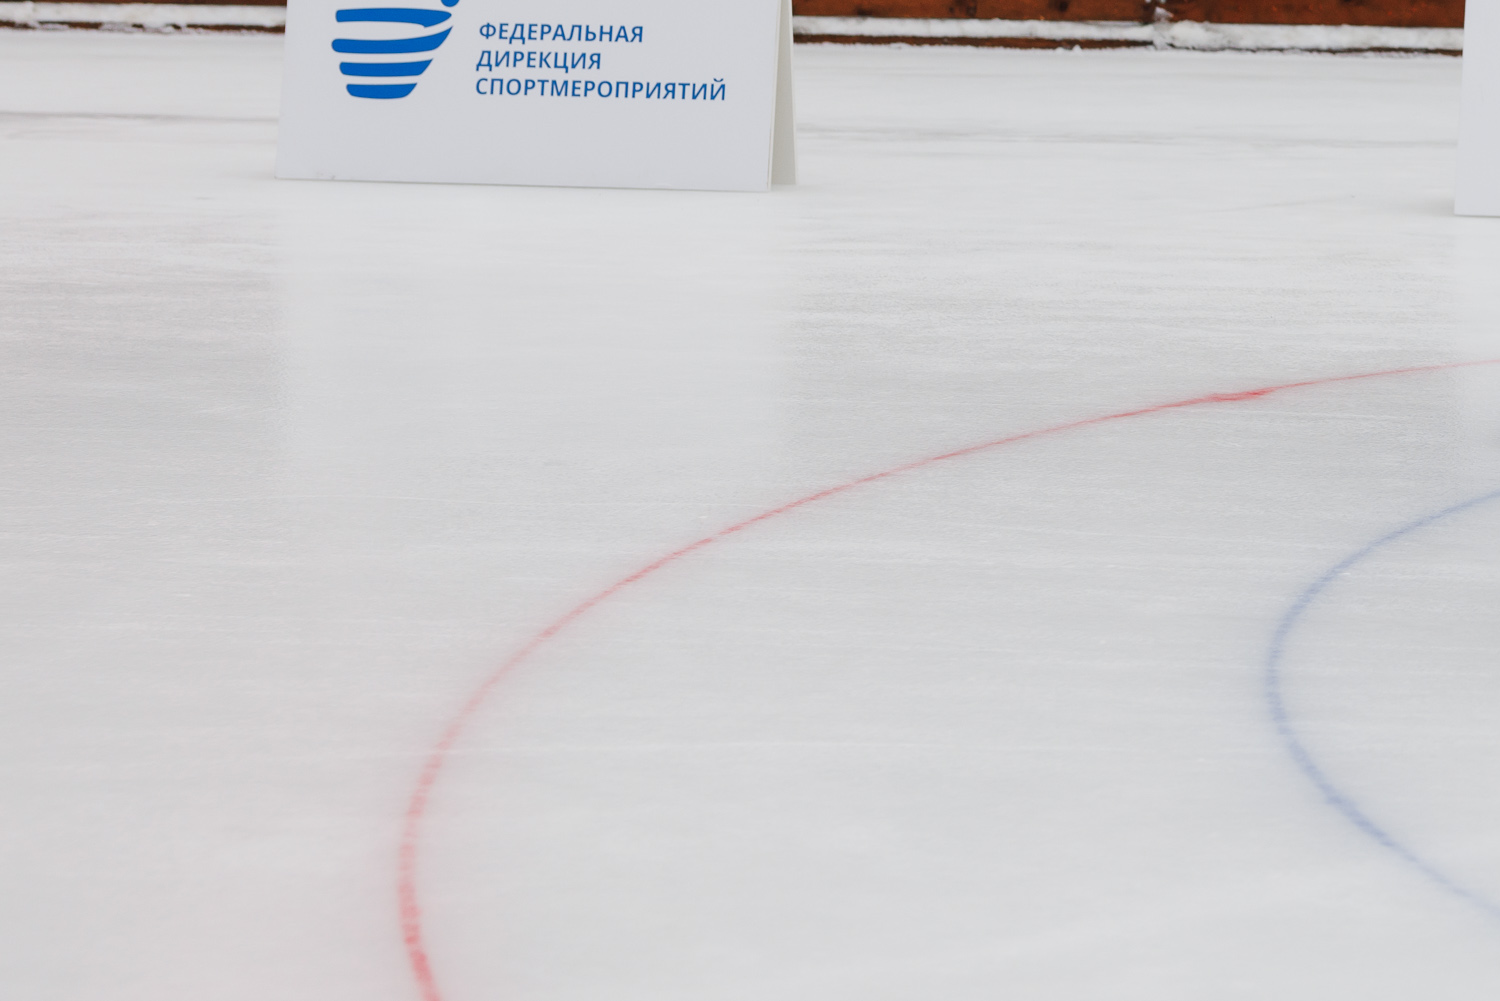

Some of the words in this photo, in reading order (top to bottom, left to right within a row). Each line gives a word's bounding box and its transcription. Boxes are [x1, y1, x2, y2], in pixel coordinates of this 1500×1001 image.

[479, 22, 644, 45] ФЕДЕРАЛЬНАЯ
[476, 50, 602, 73] ДИРЕКЦИЯ
[475, 78, 727, 101] СПОРТМЕРОПРИЯТИЙ
